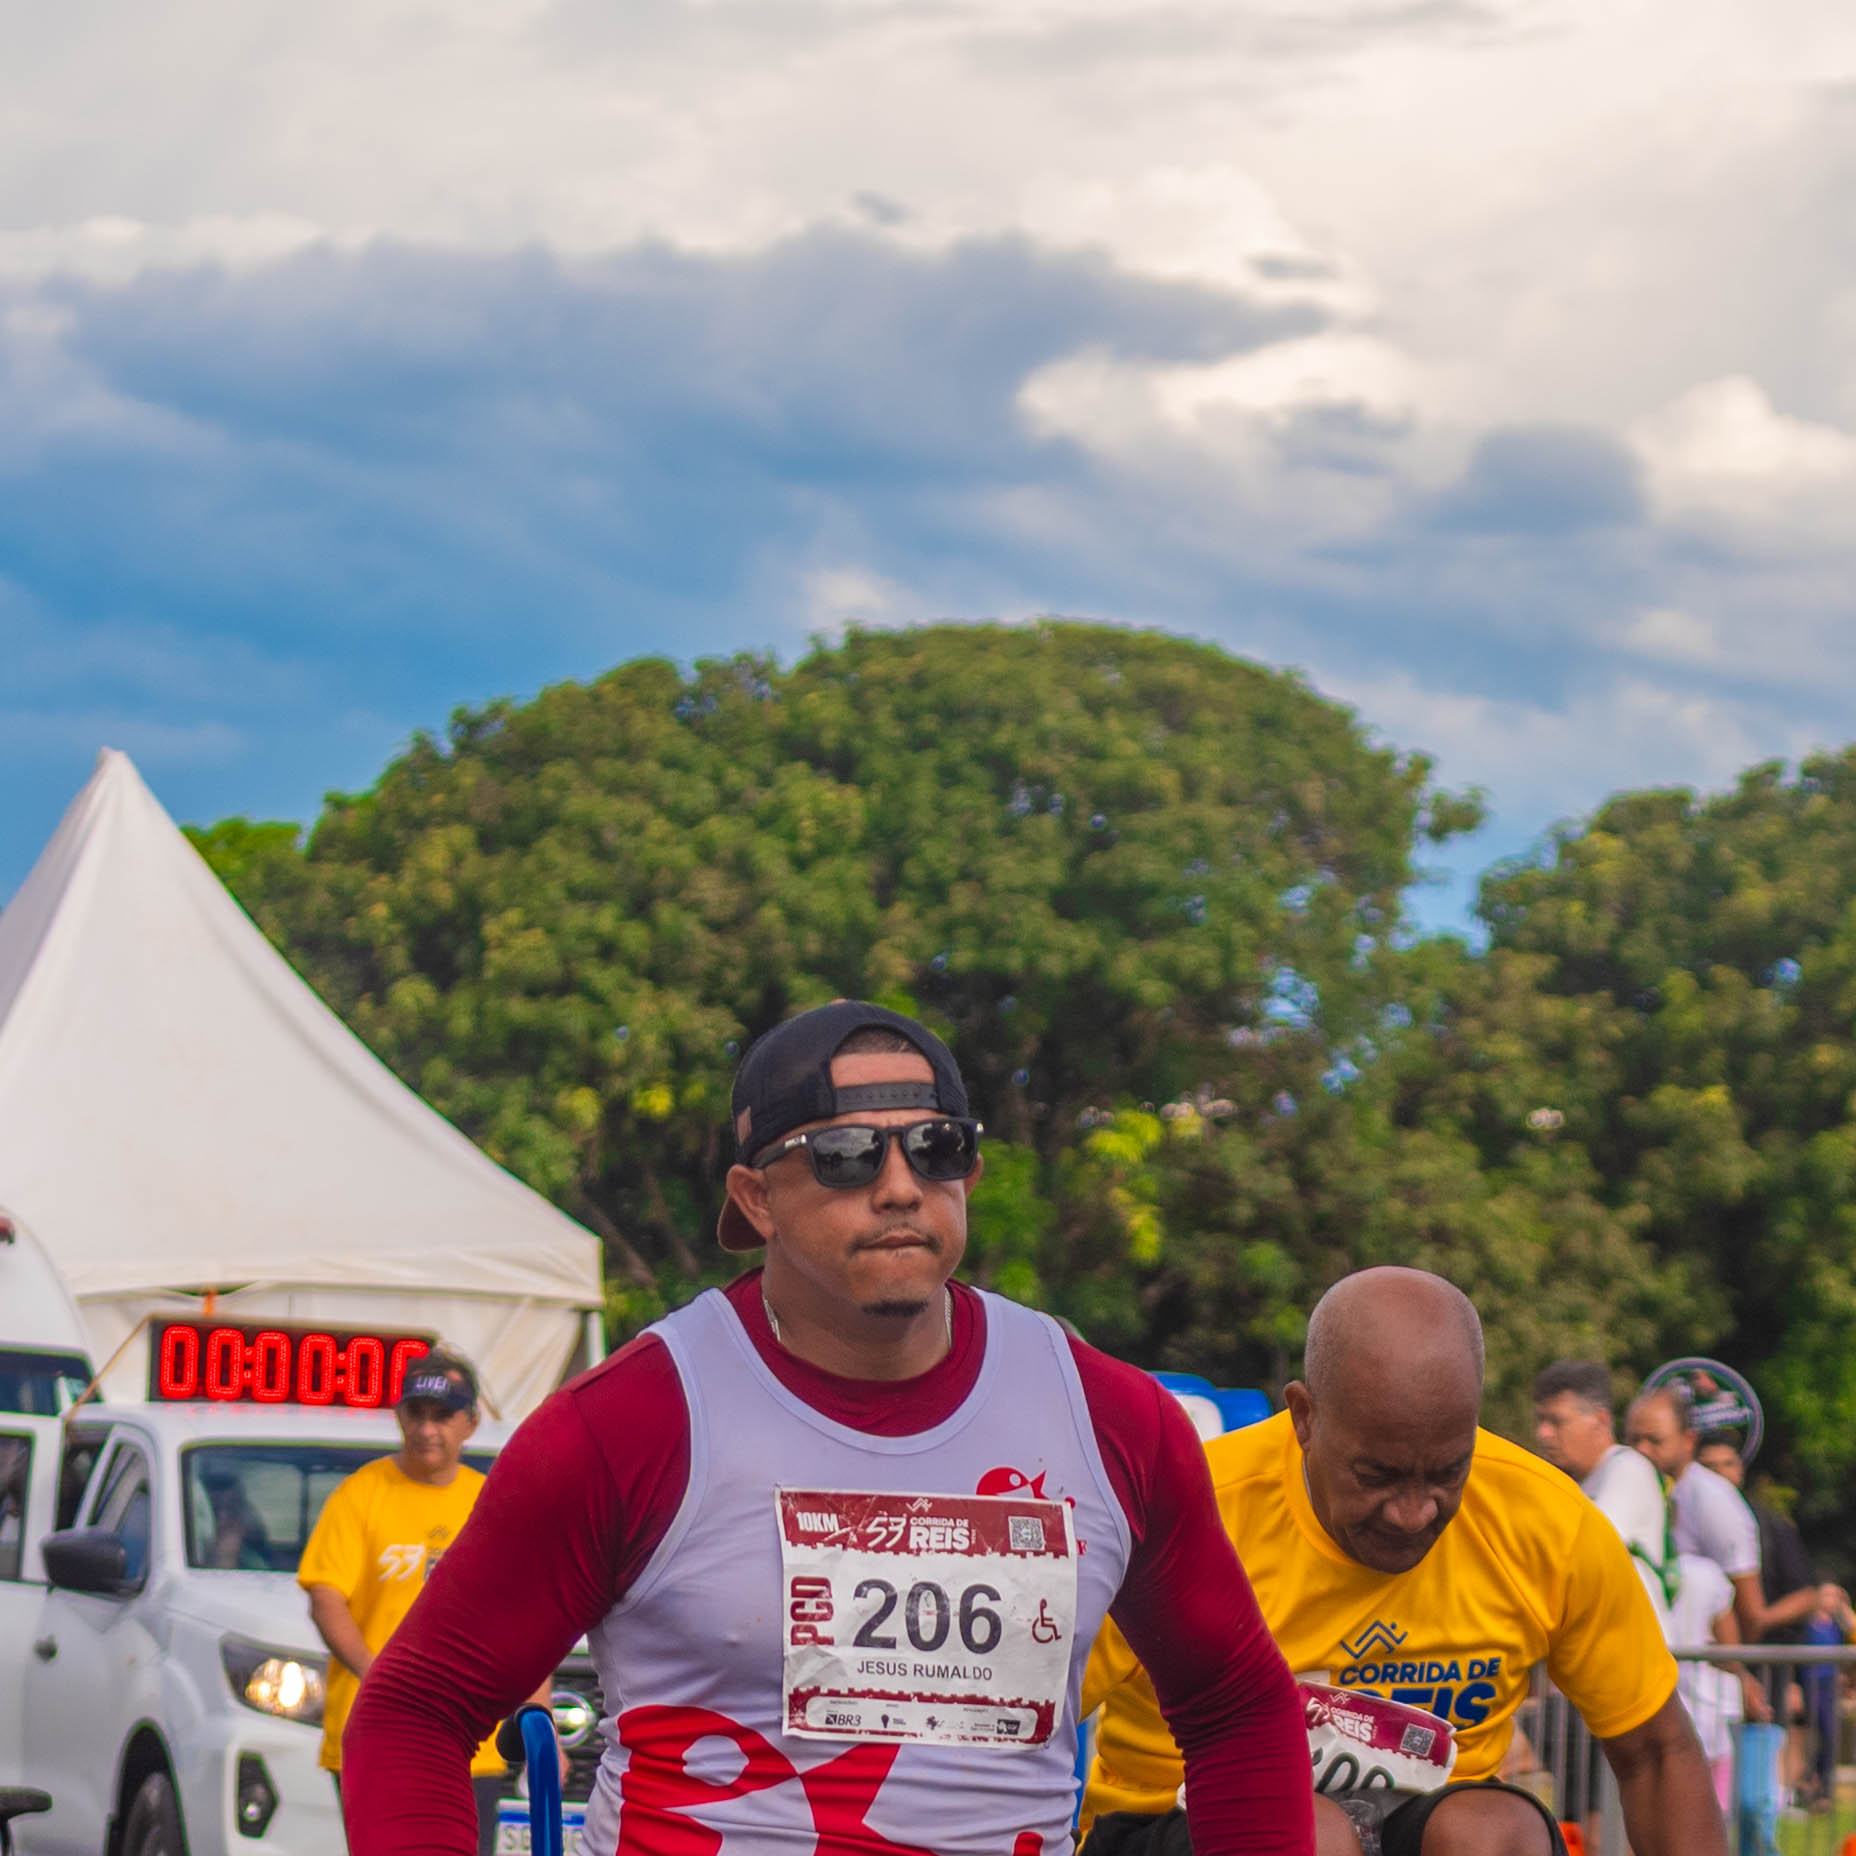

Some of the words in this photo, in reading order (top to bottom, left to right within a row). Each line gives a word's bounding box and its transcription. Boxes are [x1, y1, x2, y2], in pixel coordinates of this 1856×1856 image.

[796, 1511, 840, 1533] 10KM
[909, 1516, 955, 1527] CORRIDA
[955, 1518, 969, 1528] DE
[909, 1526, 970, 1551] REIS
[790, 1576, 835, 1647] PCD
[852, 1578, 1003, 1655] 206
[857, 1660, 908, 1677] JESUS
[912, 1662, 993, 1681] RUMALDO
[1338, 1659, 1463, 1686] CORRIDA
[1466, 1656, 1502, 1682] DE
